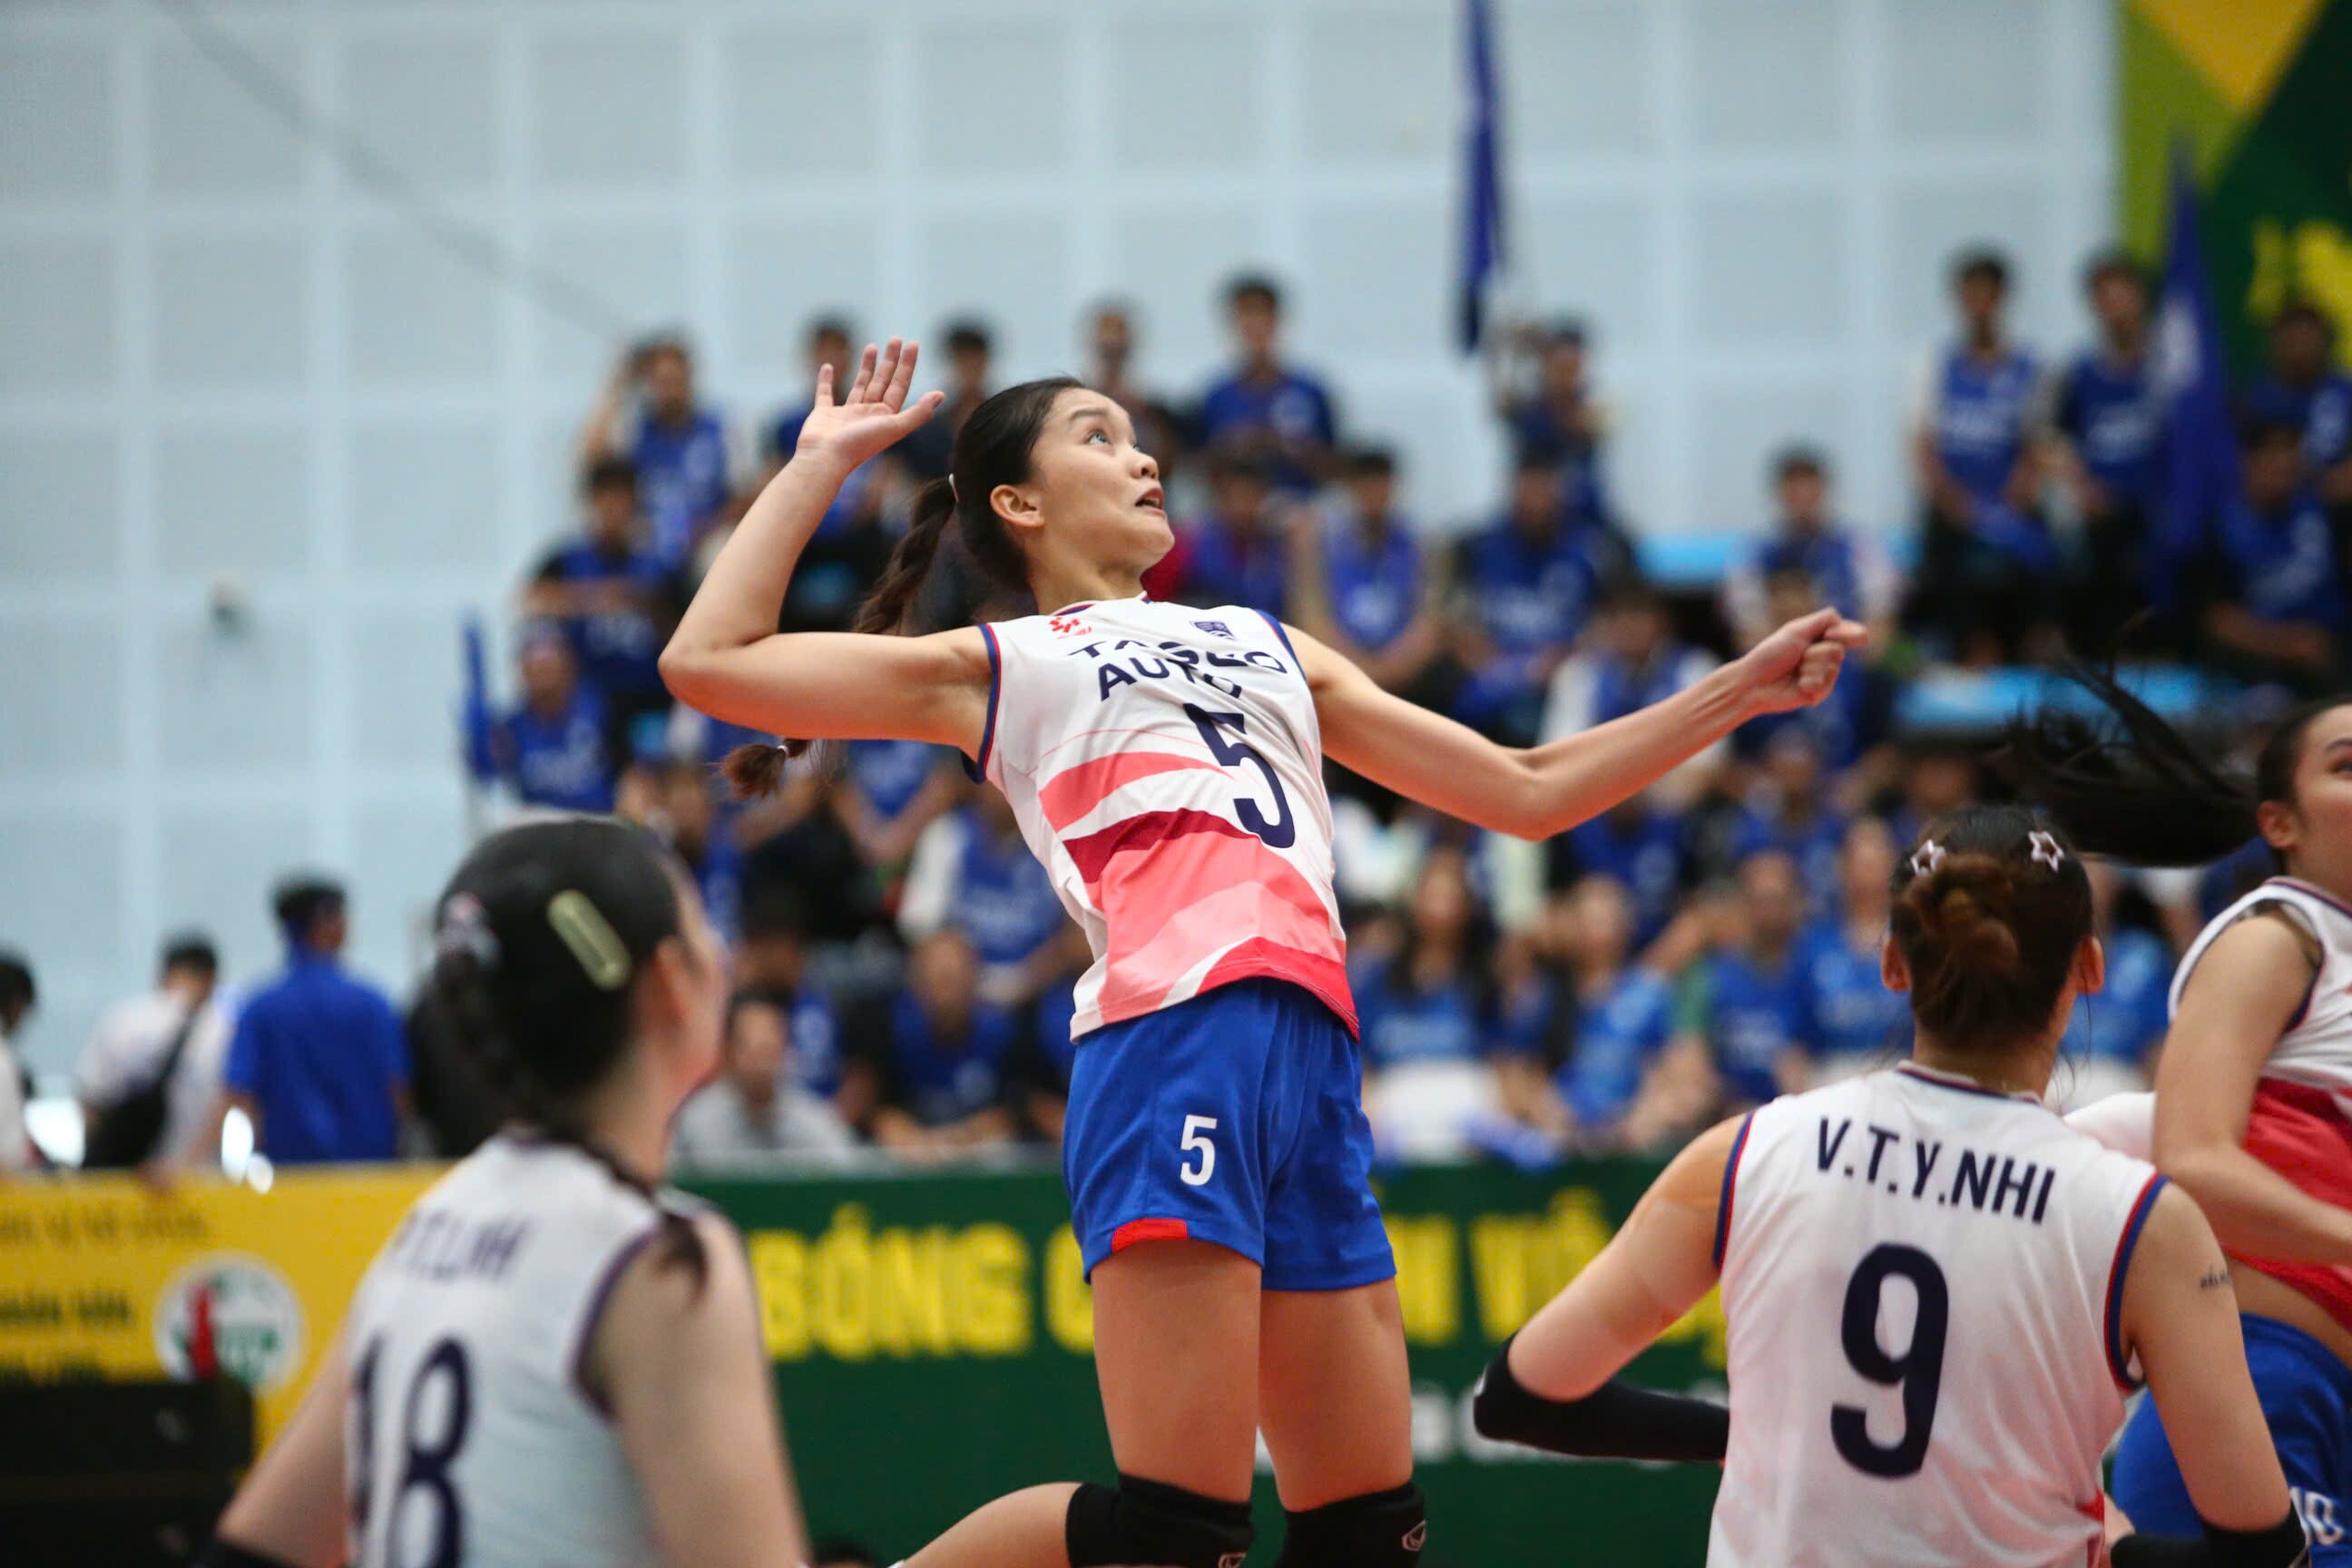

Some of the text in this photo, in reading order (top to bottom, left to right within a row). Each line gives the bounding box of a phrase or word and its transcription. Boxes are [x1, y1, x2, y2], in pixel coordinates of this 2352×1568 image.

[1182, 702, 1297, 849] 5
[1180, 1113, 1218, 1186] 5
[1817, 1117, 2056, 1226] V.T.Y.NHI
[1829, 1241, 1949, 1481] 9
[350, 1332, 472, 1568] 18
